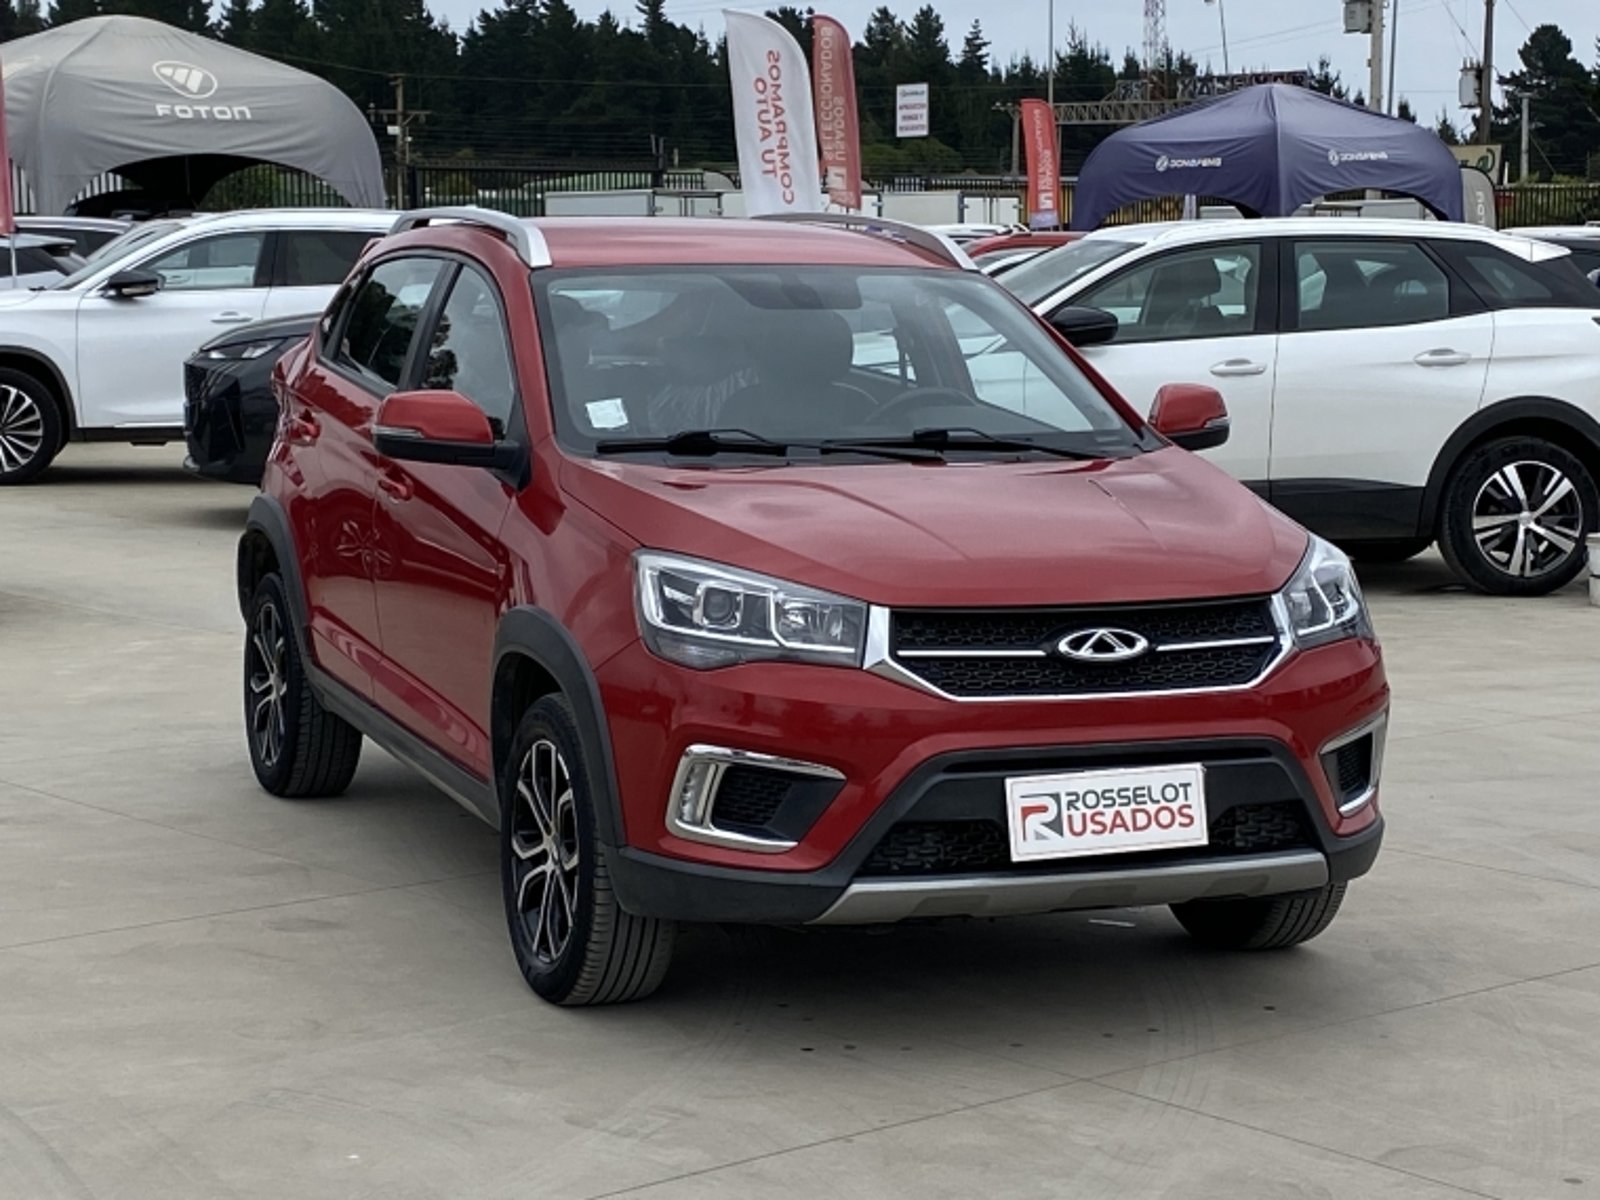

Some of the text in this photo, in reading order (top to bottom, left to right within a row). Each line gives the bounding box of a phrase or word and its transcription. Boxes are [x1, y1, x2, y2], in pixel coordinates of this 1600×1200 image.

[155, 104, 252, 119] FOTON
[1065, 782, 1192, 812] ROSSELOT
[1066, 804, 1195, 837] USADOS
